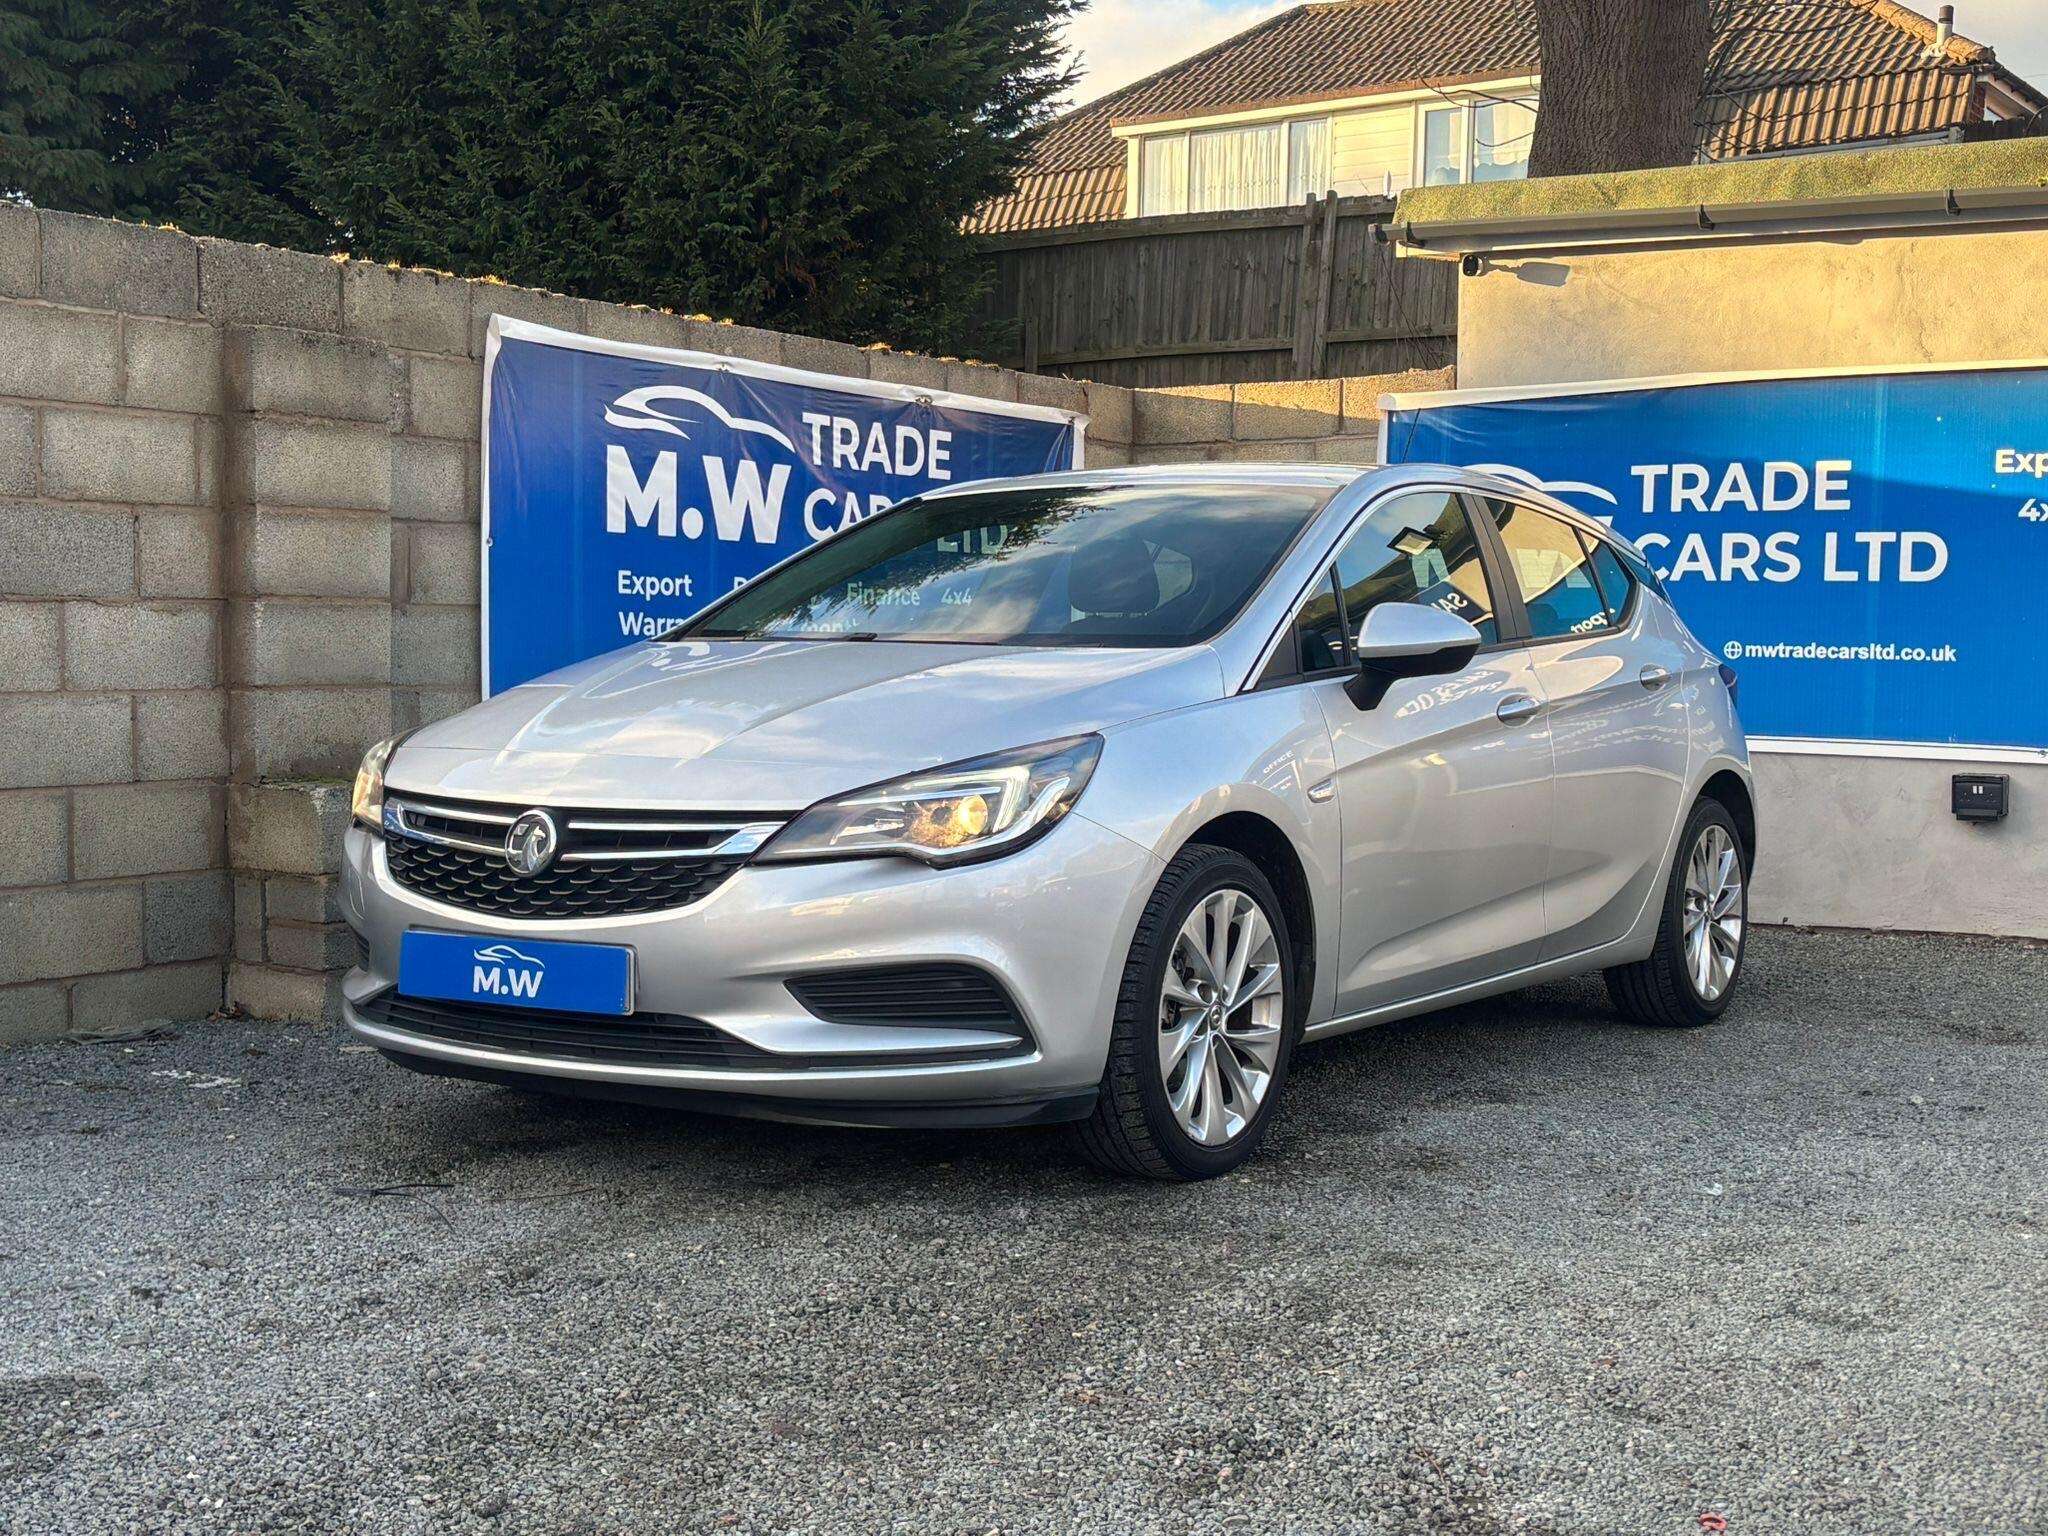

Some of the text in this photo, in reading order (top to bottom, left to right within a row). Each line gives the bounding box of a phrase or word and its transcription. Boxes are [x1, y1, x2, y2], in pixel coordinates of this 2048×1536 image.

[802, 412, 952, 480] TRADE
[607, 444, 792, 544] M.W
[1631, 460, 1852, 513] TRADE
[1633, 532, 1801, 583] CARS
[1824, 532, 1949, 583] LTD
[618, 570, 693, 601] Export
[847, 581, 921, 606] Finance
[941, 587, 973, 606] 4x4
[1744, 641, 1957, 662] mwtradecarsltd.co.uk
[473, 965, 544, 998] M.W
